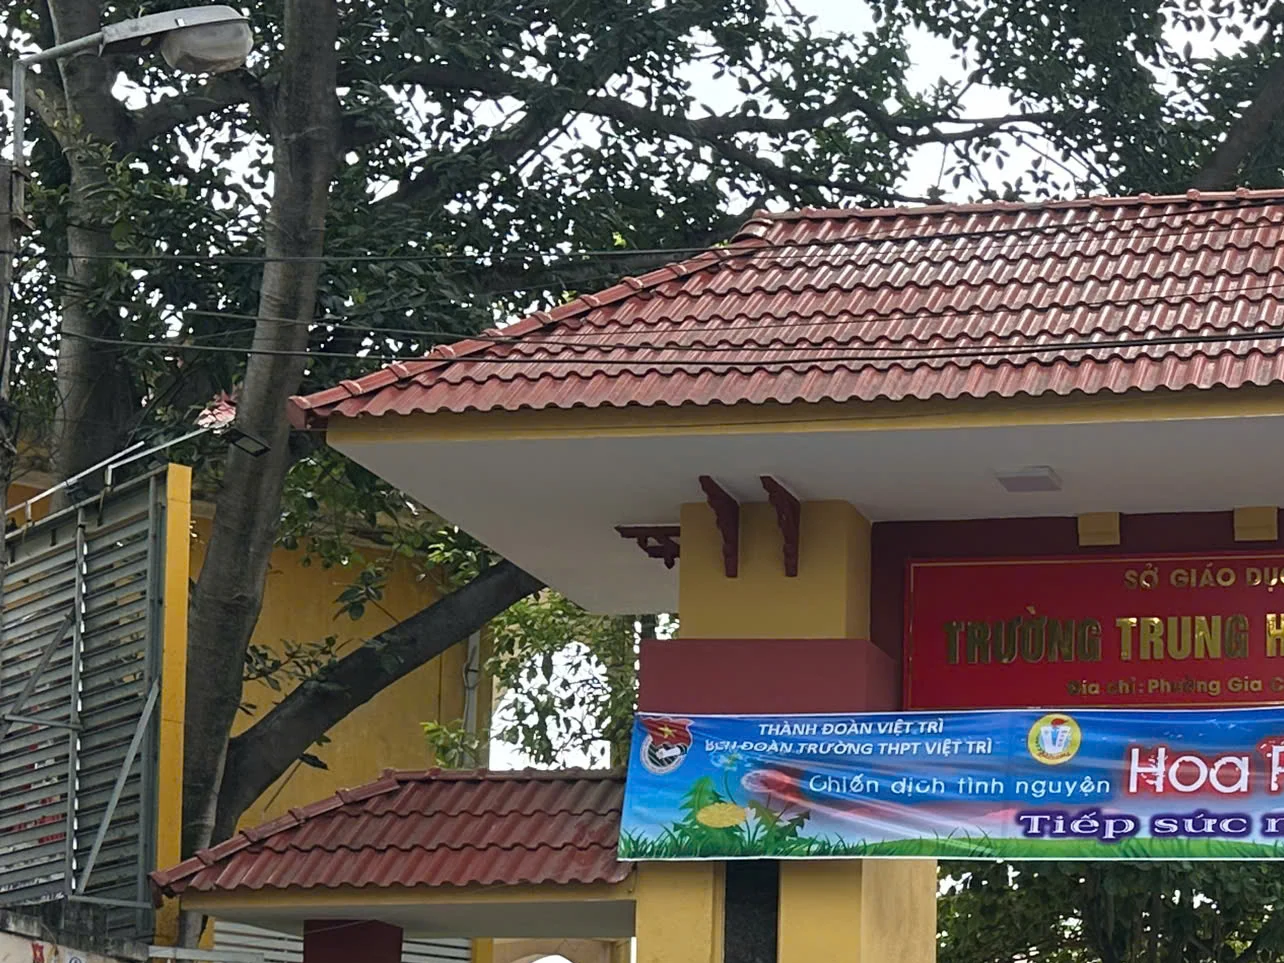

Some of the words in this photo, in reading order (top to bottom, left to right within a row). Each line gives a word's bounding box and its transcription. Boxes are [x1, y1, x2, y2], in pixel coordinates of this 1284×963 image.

[1124, 562, 1160, 589] SỞ
[1170, 562, 1236, 588] GIÁO
[943, 605, 1102, 664] TRƯỜNG
[1116, 614, 1249, 660] TRUNG
[1228, 676, 1262, 692] Gia
[758, 721, 817, 736] THÀNH
[821, 719, 872, 735] ĐOÀN
[877, 719, 913, 736] VIỆT
[919, 718, 944, 734] TRÌ
[797, 740, 874, 755] TRƯỜNG
[879, 742, 921, 755] THPT
[925, 738, 962, 757] VIỆT
[966, 737, 993, 755] TRÌ
[1128, 747, 1250, 793] Hoa
[809, 773, 880, 793] Chiến
[890, 777, 946, 797] dịch
[957, 775, 1004, 794] tình
[1015, 775, 1111, 797] nguyện
[1020, 811, 1134, 839] Tiếp
[1154, 813, 1248, 834] sức
